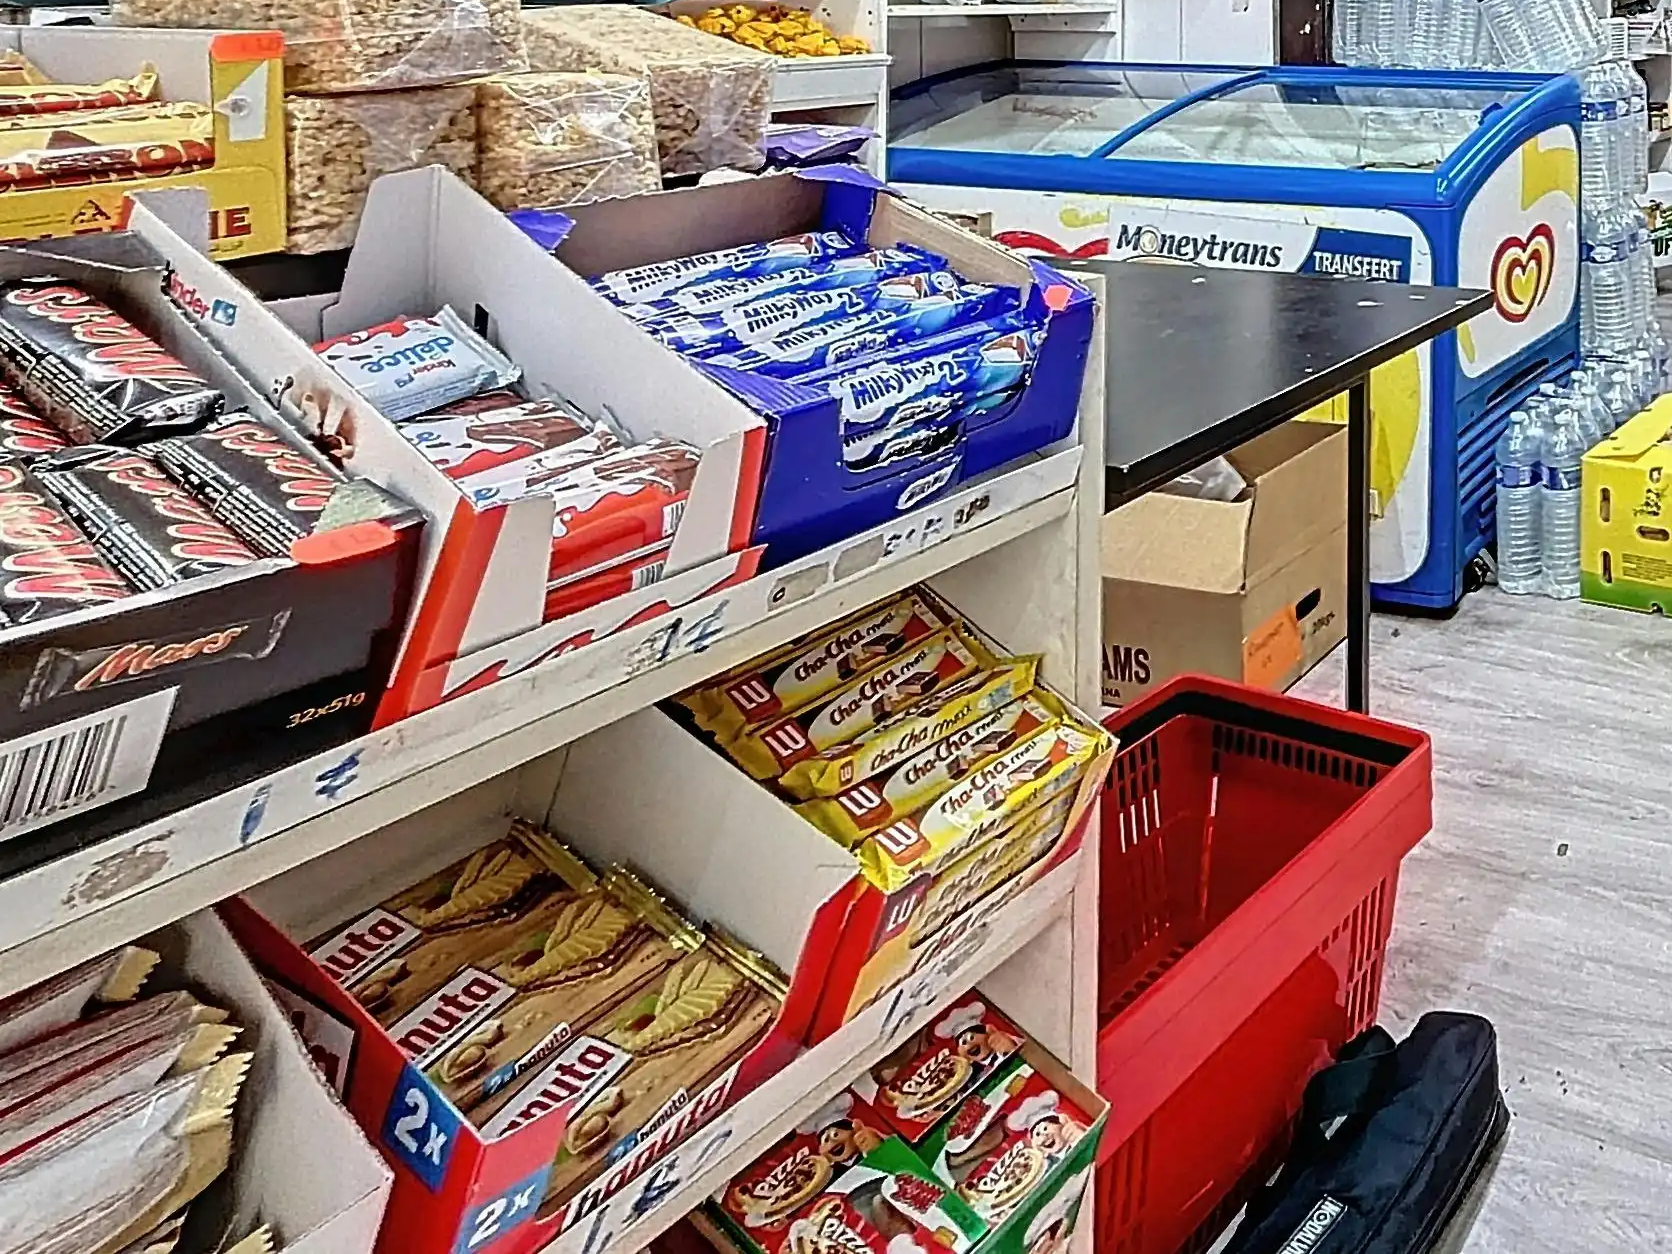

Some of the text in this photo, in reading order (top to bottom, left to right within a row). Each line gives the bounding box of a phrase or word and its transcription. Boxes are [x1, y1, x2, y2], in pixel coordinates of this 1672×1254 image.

[623, 252, 719, 293] MilkyWay
[1116, 223, 1402, 281] Moneytrans TRANSFERT
[742, 291, 833, 333] MilkyWay
[75, 625, 249, 691] Mars
[737, 681, 772, 710] LU
[794, 627, 864, 682] Cha-Cha
[1102, 642, 1151, 685] AMS
[286, 691, 366, 729] 32x51g
[773, 724, 808, 758] LU
[829, 667, 899, 727] Cha-Cha
[838, 785, 882, 817] LU
[903, 728, 975, 784] Cha-Cha
[876, 819, 919, 852] LU
[886, 894, 917, 933] LU
[319, 916, 405, 981] nuta
[396, 976, 499, 1058] nuta
[500, 1044, 616, 1139] nuta
[901, 1047, 950, 1095] PIZZA
[394, 1087, 448, 1166] 2x
[753, 1145, 811, 1199] PIZZA
[978, 1141, 1026, 1194] PIZZA
[467, 1183, 537, 1249] 2x
